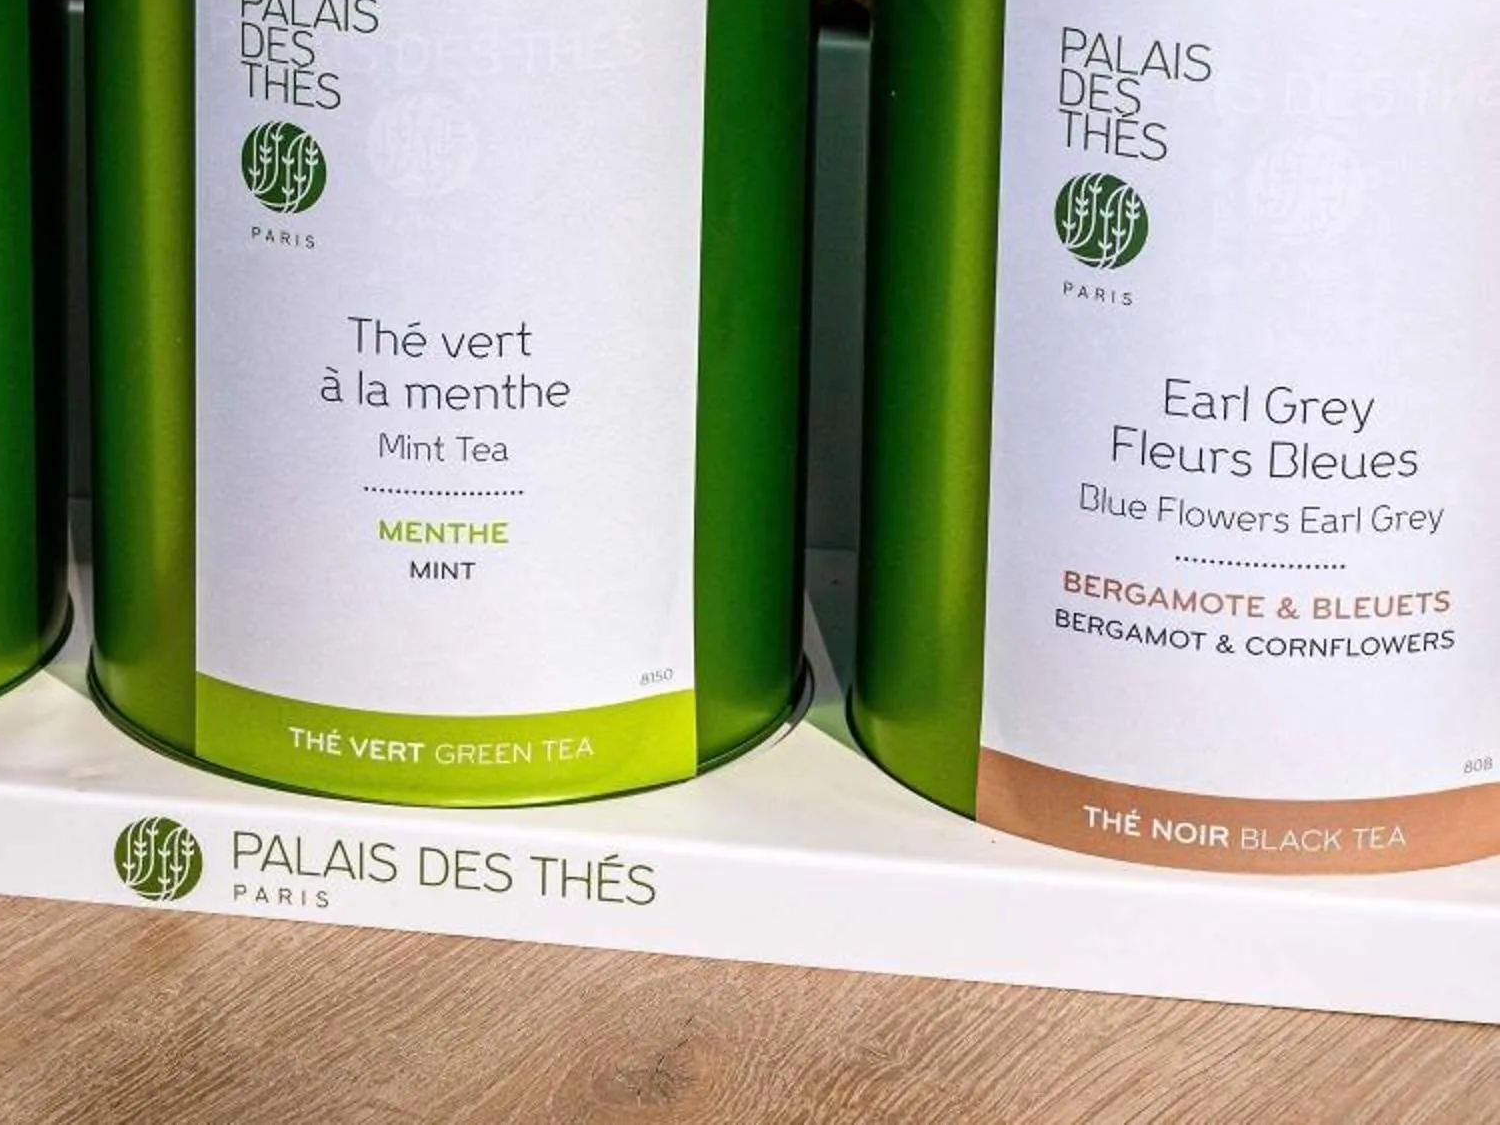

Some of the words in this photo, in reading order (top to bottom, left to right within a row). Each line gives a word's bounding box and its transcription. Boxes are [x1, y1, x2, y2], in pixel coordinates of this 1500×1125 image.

[241, 22, 315, 66] DES
[1061, 26, 1212, 82] PALAIS
[241, 62, 342, 110] THÉS
[1059, 69, 1141, 115] DES
[1059, 110, 1168, 162] THÉS
[251, 227, 315, 249] PARIS
[1063, 282, 1133, 306] PARIS
[348, 316, 426, 358] Thé
[441, 321, 533, 358] vert
[320, 367, 342, 403] à
[358, 371, 386, 406] la
[406, 374, 570, 410] menthe
[1164, 378, 1248, 423] Earl
[1265, 387, 1375, 434] Grey
[379, 433, 444, 462] Mint
[456, 436, 508, 462] Tea
[1112, 425, 1251, 477] Fleurs
[1269, 441, 1418, 480] Bleues
[379, 520, 509, 544] MENTHE
[1080, 483, 1146, 520] Blue
[1158, 496, 1289, 534] Flowers
[1301, 506, 1361, 534] Earl
[1370, 505, 1444, 535] Grey
[409, 562, 476, 581] MINT
[1063, 570, 1265, 618] BERGAMOTE
[1277, 597, 1300, 620] &
[1313, 590, 1451, 621] BLEUETS
[1055, 609, 1207, 651] BERGAMOT
[1216, 635, 1235, 654] &
[1246, 630, 1455, 658] CORNFLOWERS
[289, 726, 341, 757] THÉ
[349, 737, 425, 762] VERT
[436, 744, 531, 764] GREEN
[541, 738, 593, 760] TEA
[1084, 805, 1140, 837] THÉ
[1152, 819, 1228, 849] NOIR
[1240, 828, 1342, 852] BLACK
[1353, 826, 1406, 849] TEA
[233, 830, 398, 883] PALAIS
[419, 847, 512, 893] DES
[531, 854, 656, 906] THÉS
[234, 885, 329, 909] PARIS
